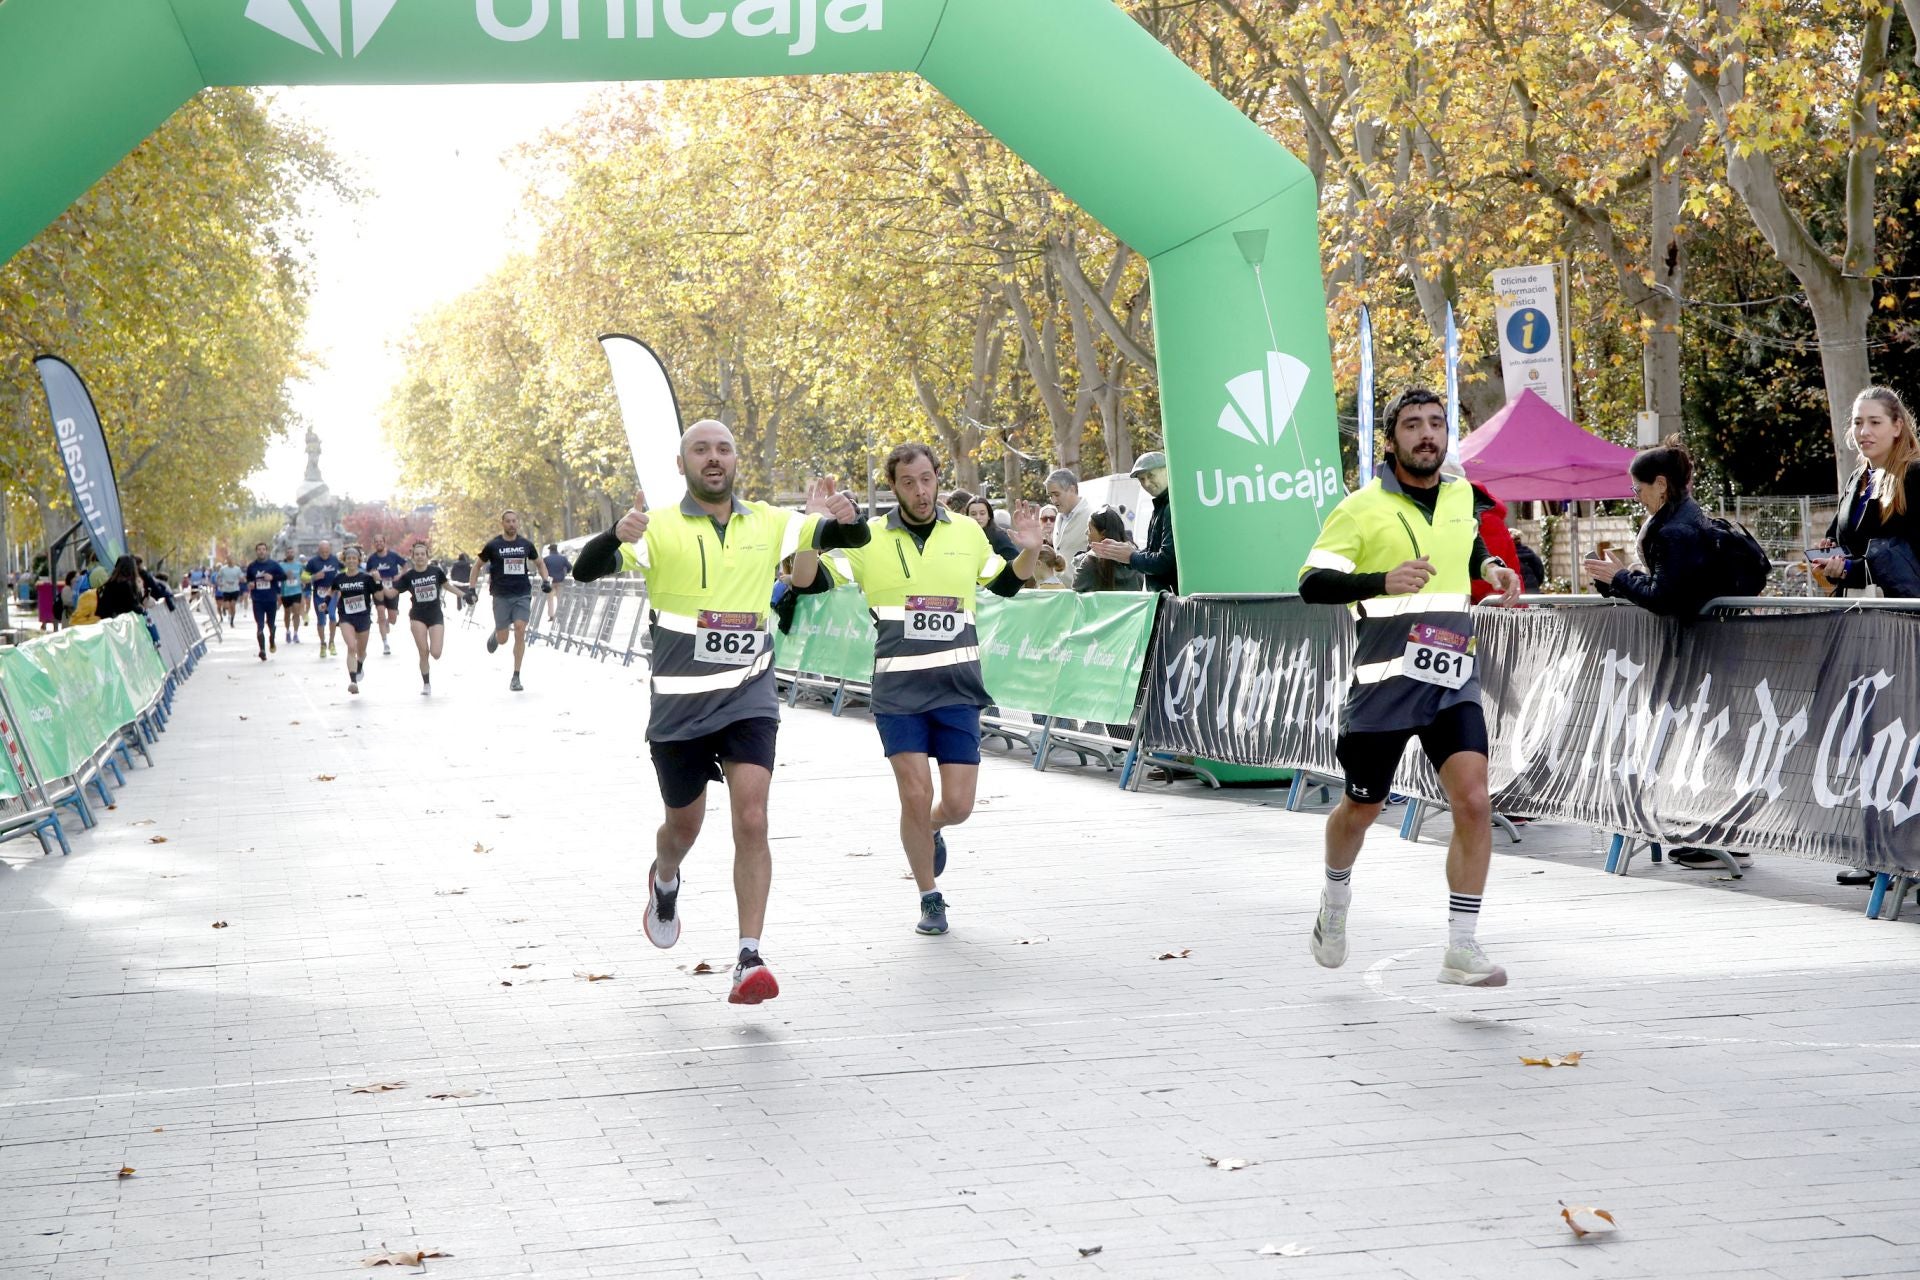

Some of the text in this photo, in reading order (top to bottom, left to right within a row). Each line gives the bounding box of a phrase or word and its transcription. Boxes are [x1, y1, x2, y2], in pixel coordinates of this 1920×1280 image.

[1501, 274, 1537, 286] Oficina de
[1196, 458, 1338, 508] Unicaja
[498, 546, 525, 554] UEMC
[339, 581, 365, 589] UEMC
[411, 575, 437, 585] UEMC
[912, 612, 956, 632] 860
[705, 631, 755, 655] 862
[1413, 647, 1463, 678] 861
[1731, 677, 1809, 804] de
